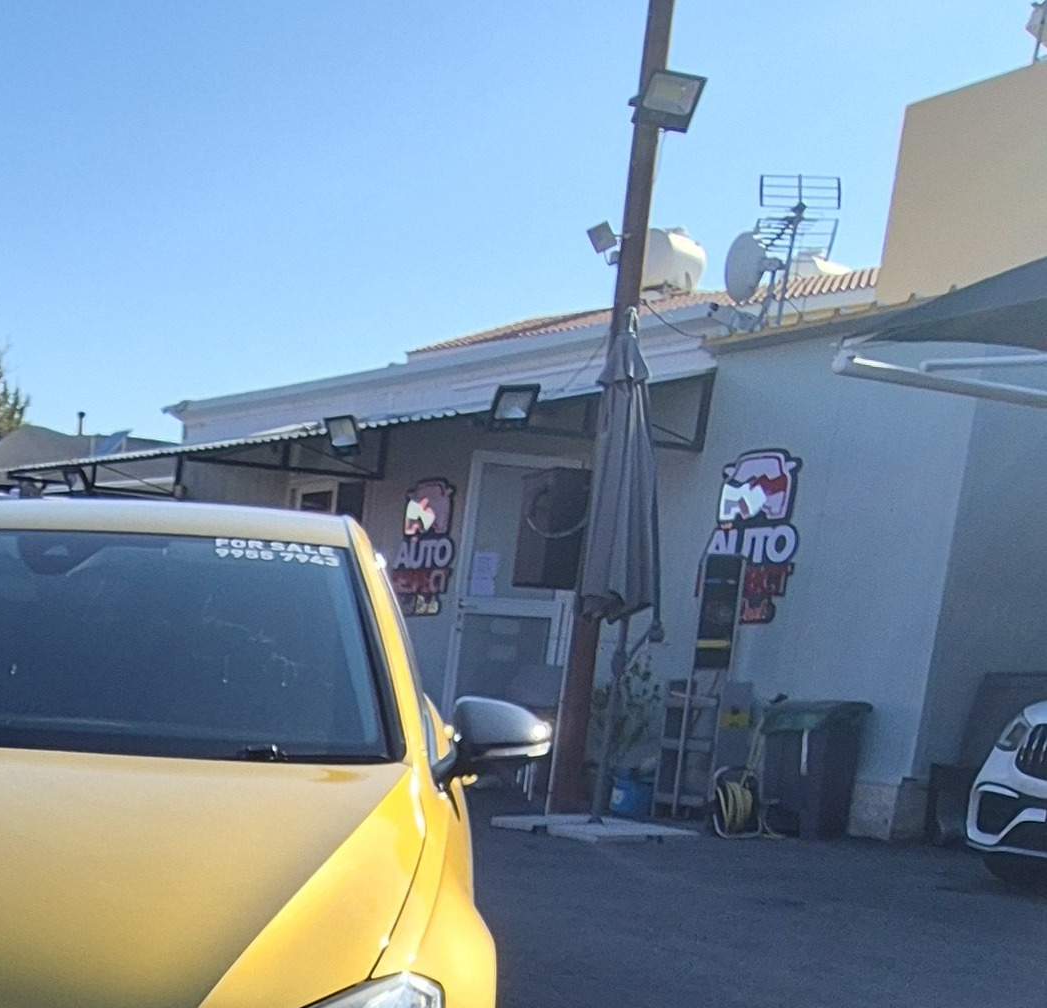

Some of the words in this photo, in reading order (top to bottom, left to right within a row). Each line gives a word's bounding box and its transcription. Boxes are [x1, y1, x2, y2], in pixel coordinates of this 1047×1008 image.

[215, 538, 264, 550] FOR
[270, 541, 335, 556] SALE
[393, 537, 453, 569] AUTO
